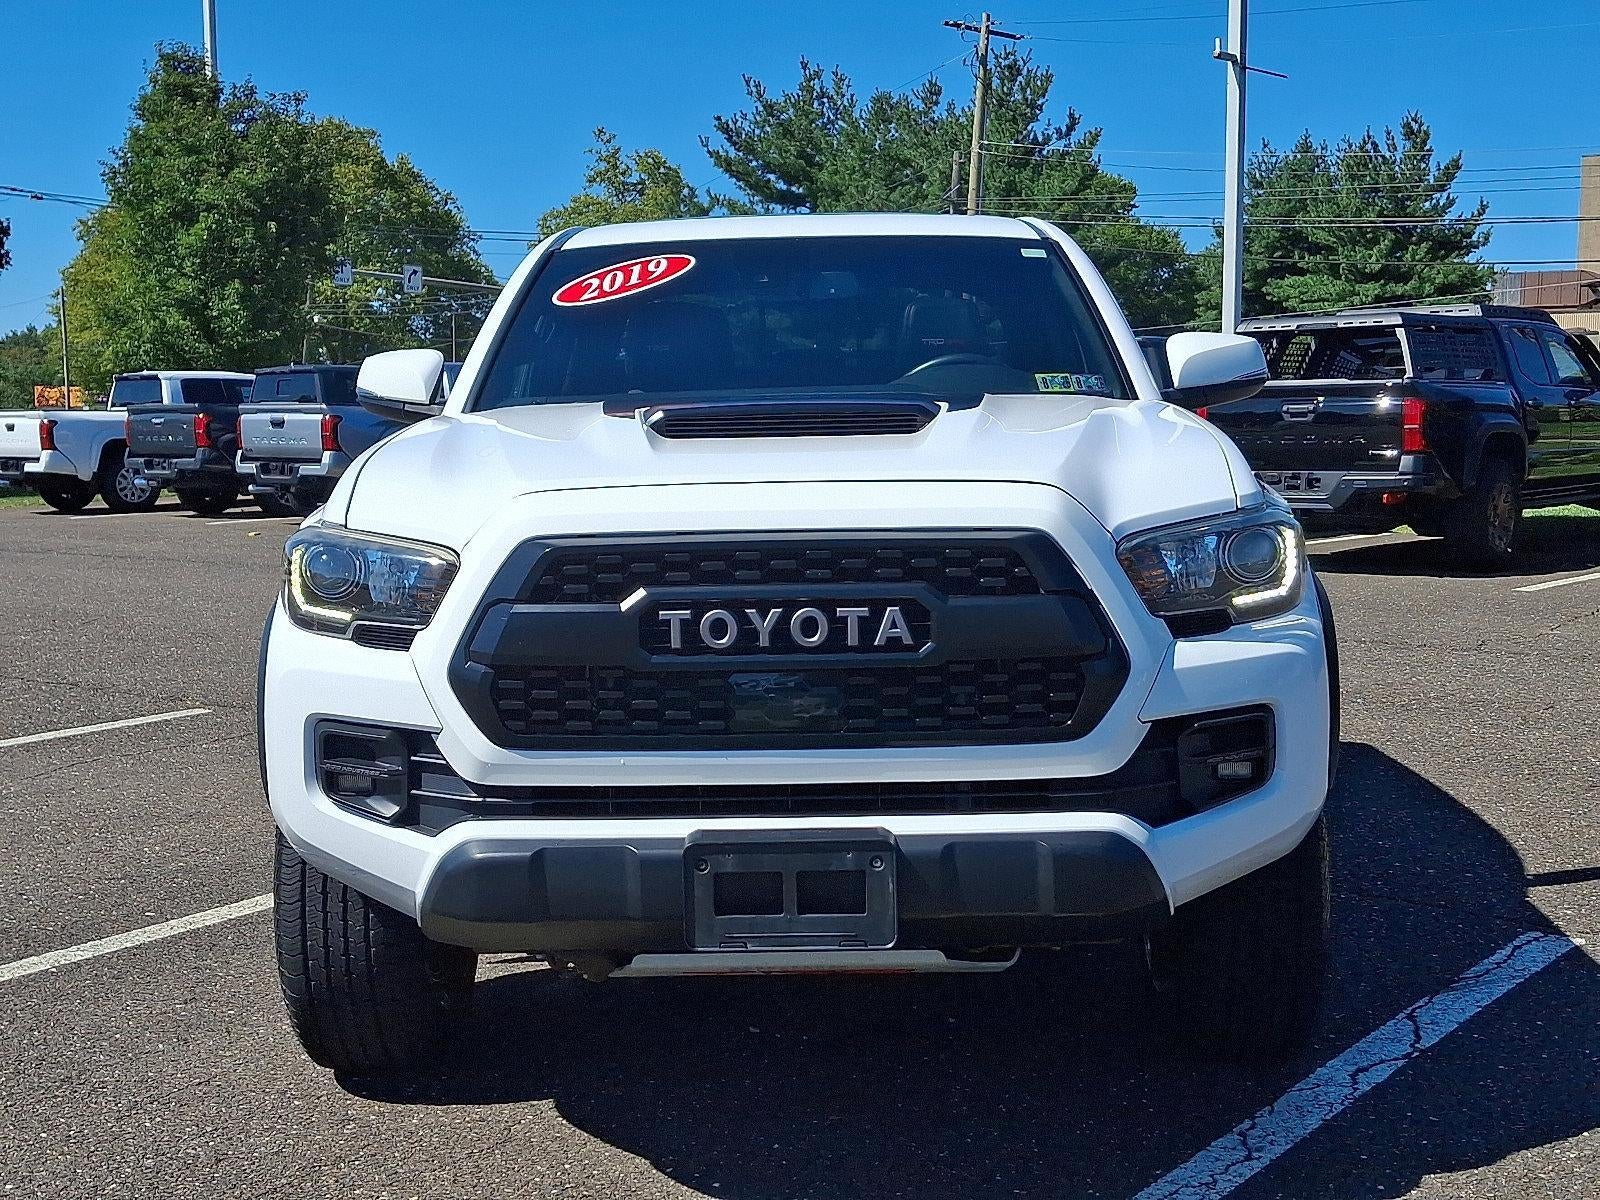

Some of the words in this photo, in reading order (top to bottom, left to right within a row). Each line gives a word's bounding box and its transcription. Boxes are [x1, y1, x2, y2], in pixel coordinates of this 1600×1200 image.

[579, 257, 669, 302] 2019
[251, 436, 308, 445] TACOMA
[658, 606, 914, 649] TOYOTA
